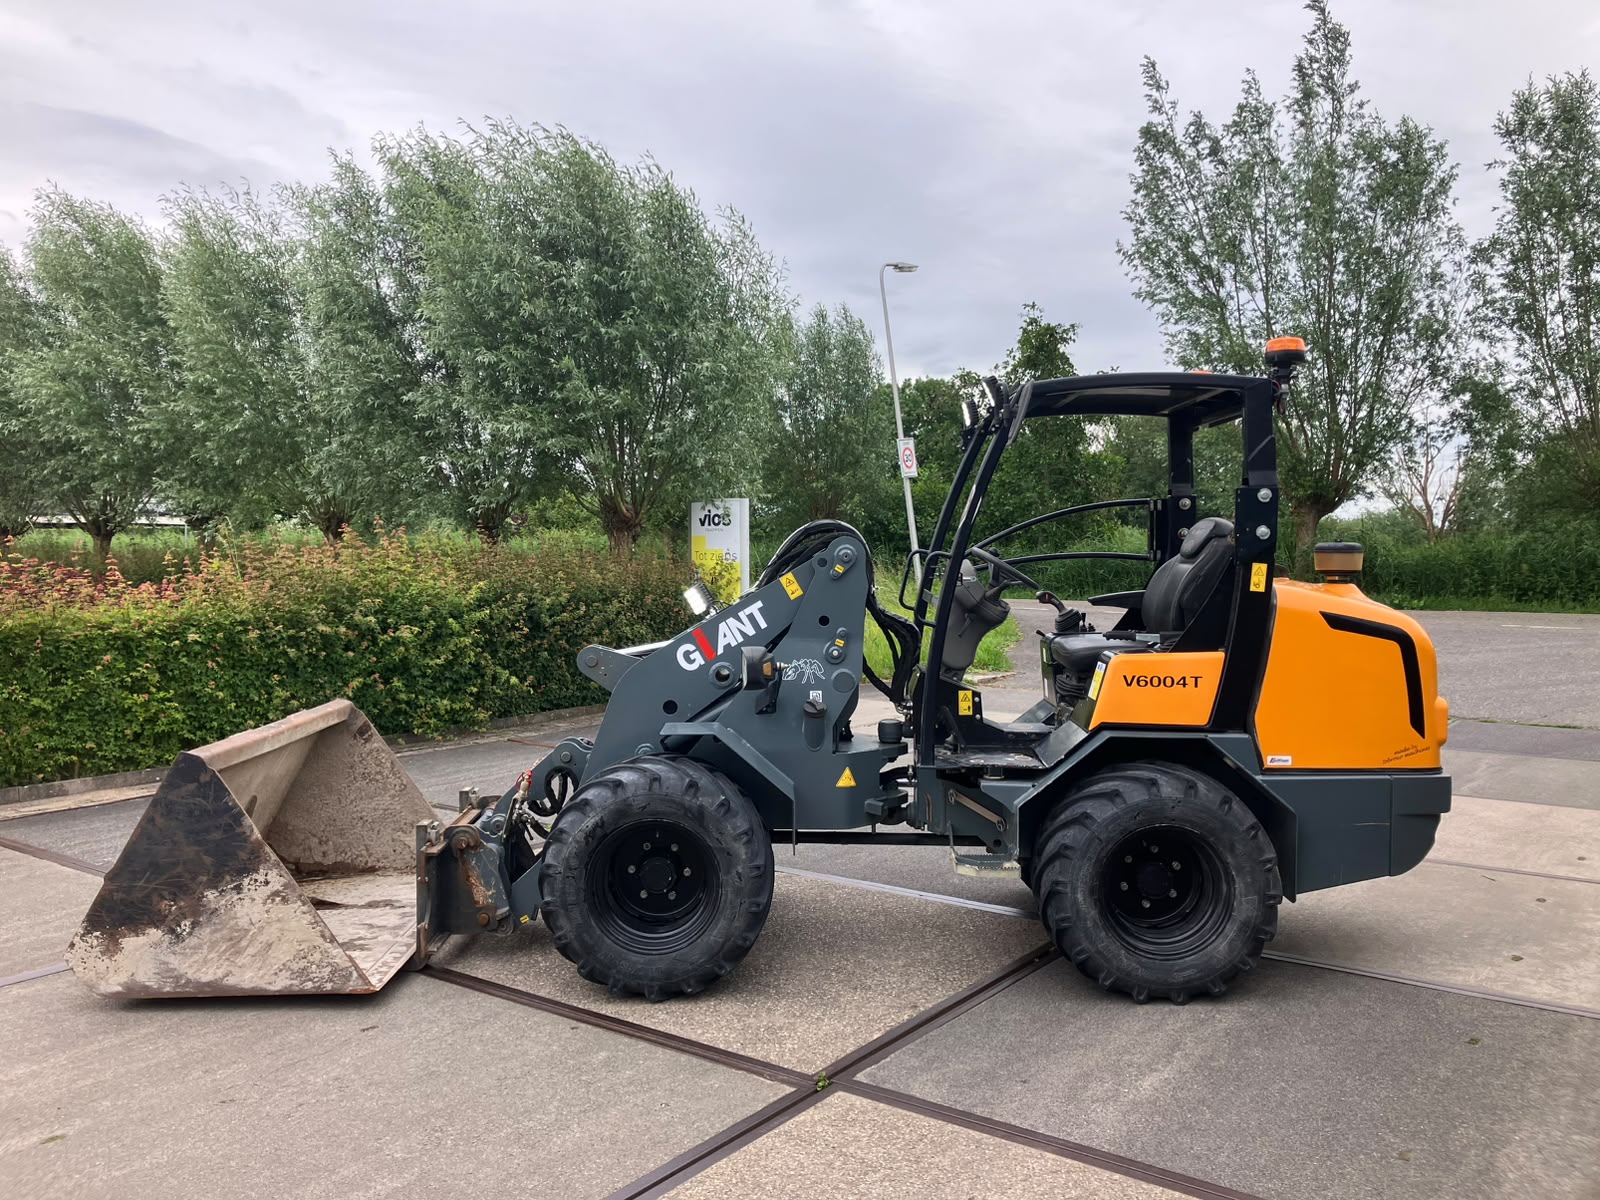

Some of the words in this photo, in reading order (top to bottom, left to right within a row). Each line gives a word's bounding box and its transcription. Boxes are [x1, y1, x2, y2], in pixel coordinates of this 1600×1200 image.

[694, 550, 708, 561] Tot
[676, 600, 768, 671] GIANT
[1122, 674, 1203, 689] V6004T
